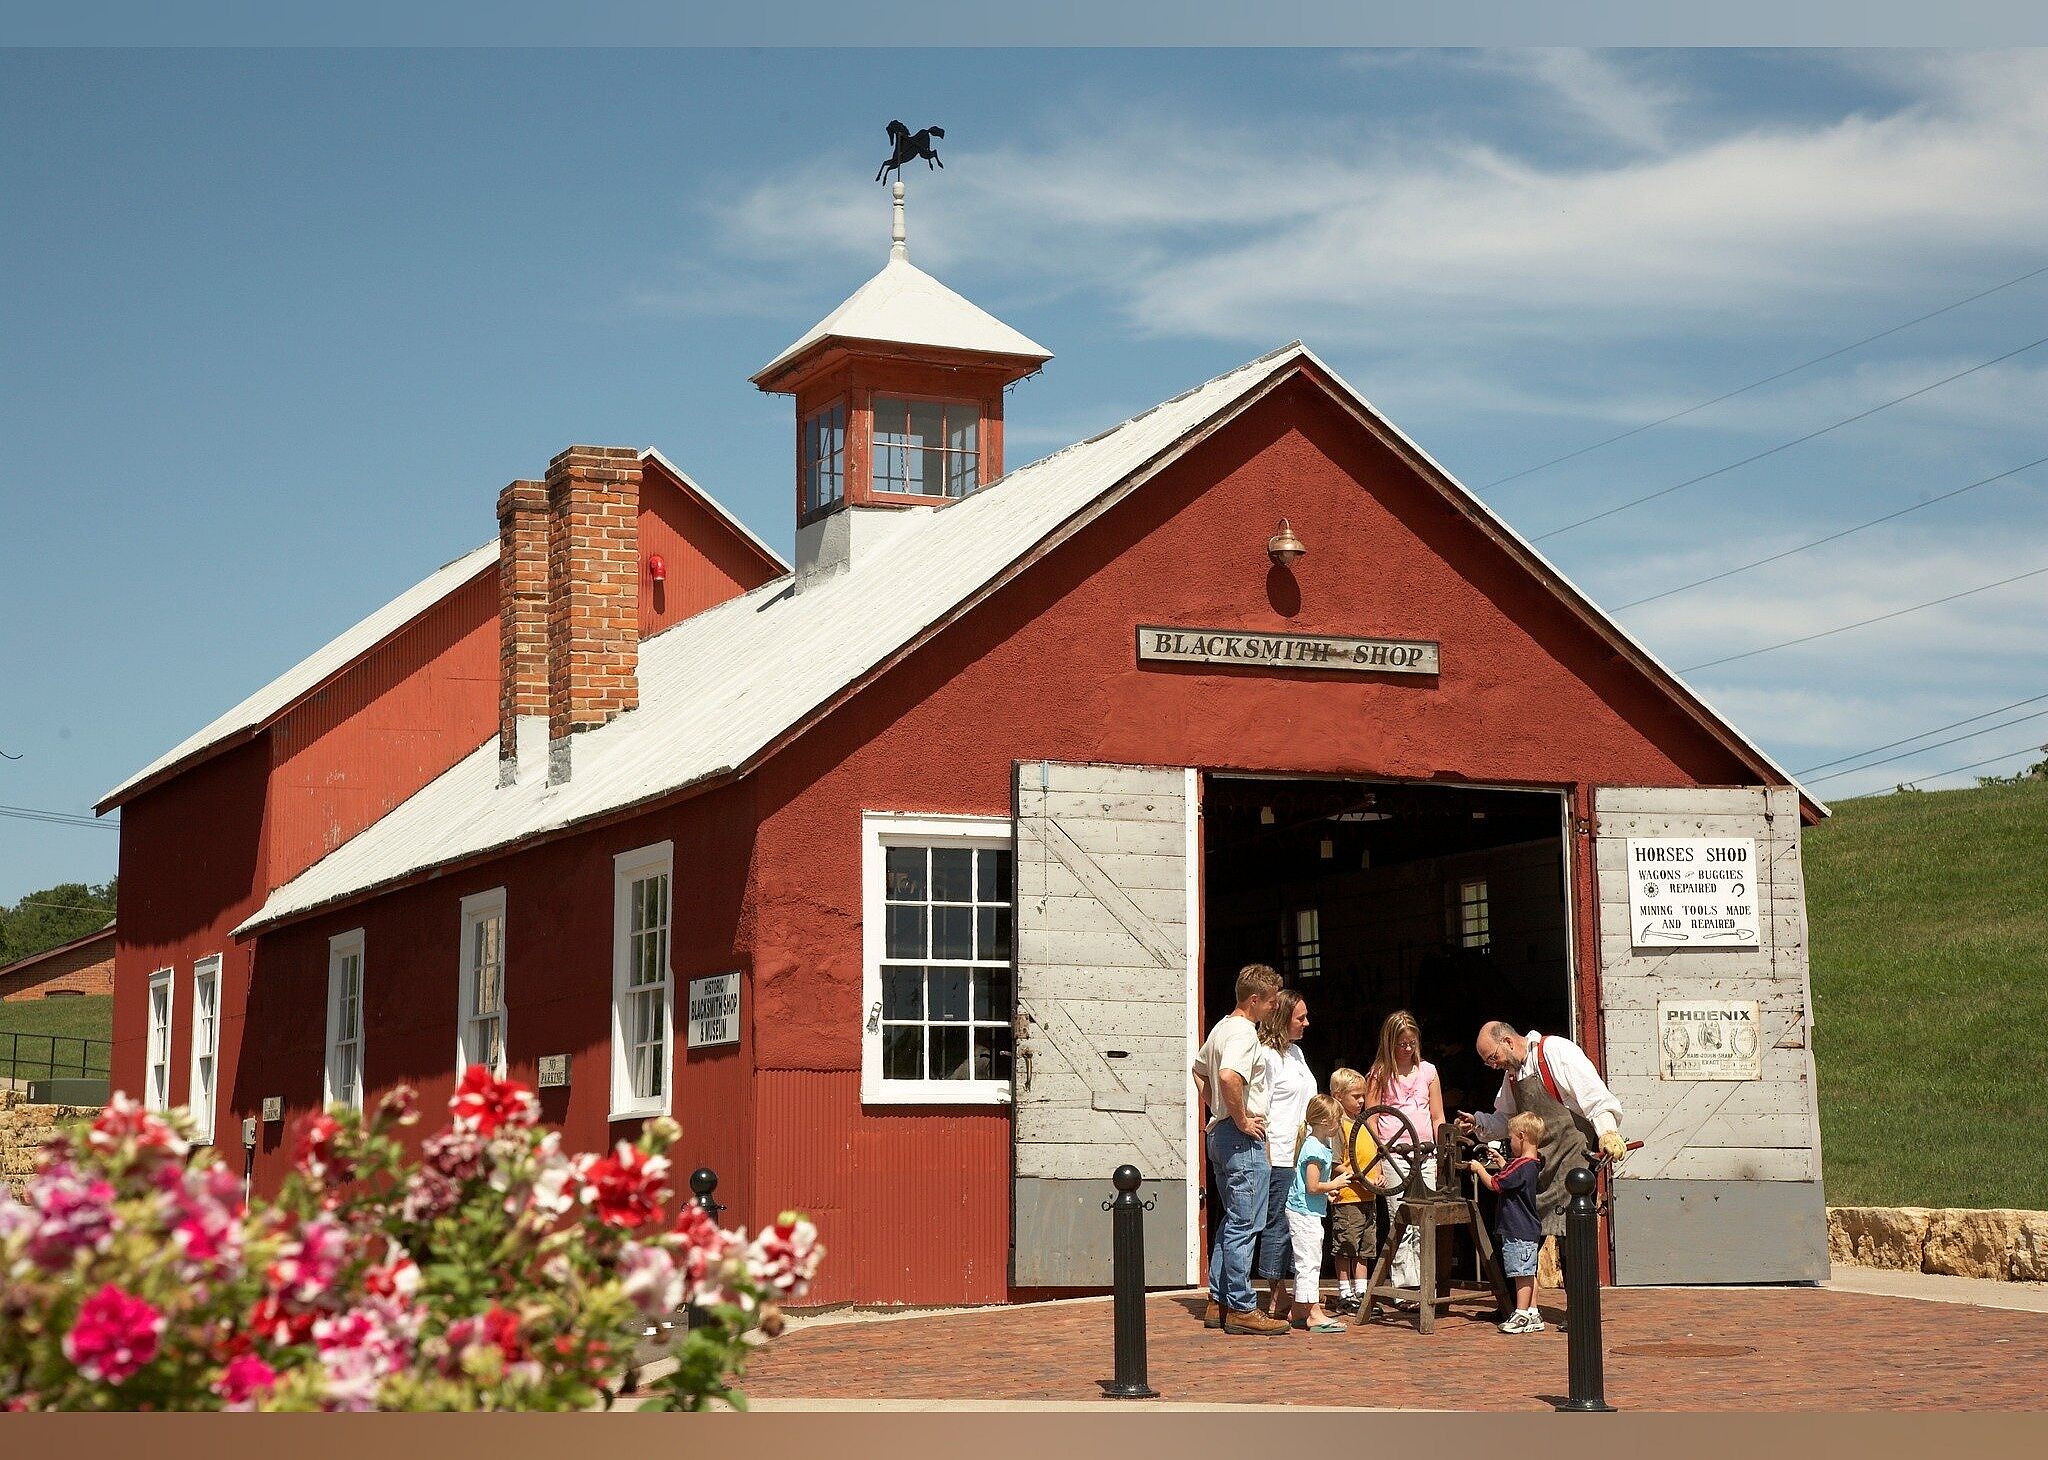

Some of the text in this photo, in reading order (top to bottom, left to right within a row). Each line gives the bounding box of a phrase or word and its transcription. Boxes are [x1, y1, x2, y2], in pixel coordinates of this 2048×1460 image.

[1153, 633, 1424, 667] BLACKSMITH SHOP
[1635, 847, 1747, 862] HORSES SHOD
[1638, 870, 1681, 880] WAGONS
[1698, 869, 1744, 880] BUGGIES
[1669, 883, 1717, 893] REPAIRED
[1640, 905, 1751, 916] MINING TOOLS MADE
[1662, 919, 1735, 929] AND REPAIRED
[704, 978, 724, 995] HISTORIC
[723, 992, 738, 1017] SHOP
[1667, 1010, 1751, 1021] PHOENIX
[705, 1018, 727, 1042] MUSEUM
